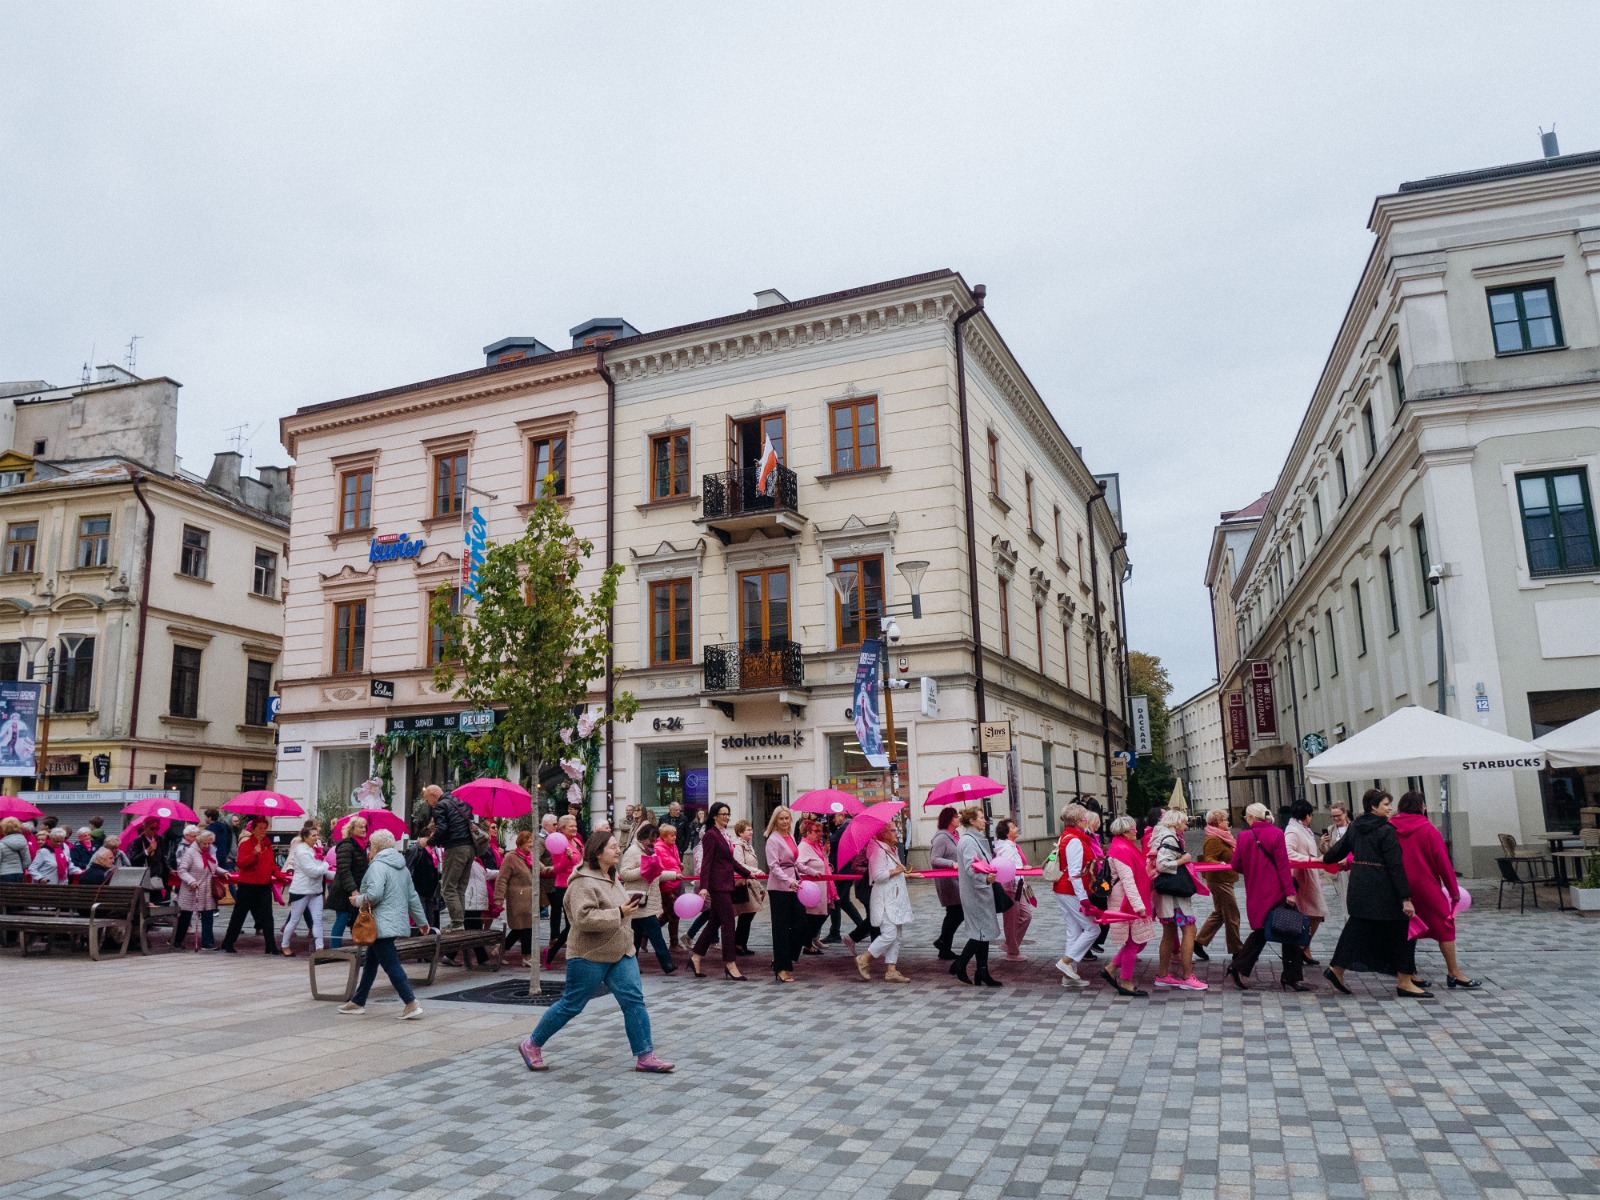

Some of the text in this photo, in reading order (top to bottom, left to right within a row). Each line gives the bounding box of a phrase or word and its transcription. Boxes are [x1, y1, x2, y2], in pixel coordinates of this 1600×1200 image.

[369, 533, 424, 563] kurier
[1256, 683, 1266, 727] RESTAURANT
[1476, 700, 1488, 709] 12
[462, 714, 491, 726] PELIER
[652, 717, 683, 731] 6-24
[1138, 708, 1148, 750] DACCARA
[1231, 709, 1239, 745] CUKIERNIA
[721, 731, 791, 749] stokrotka
[1462, 758, 1540, 770] STARBUCKS
